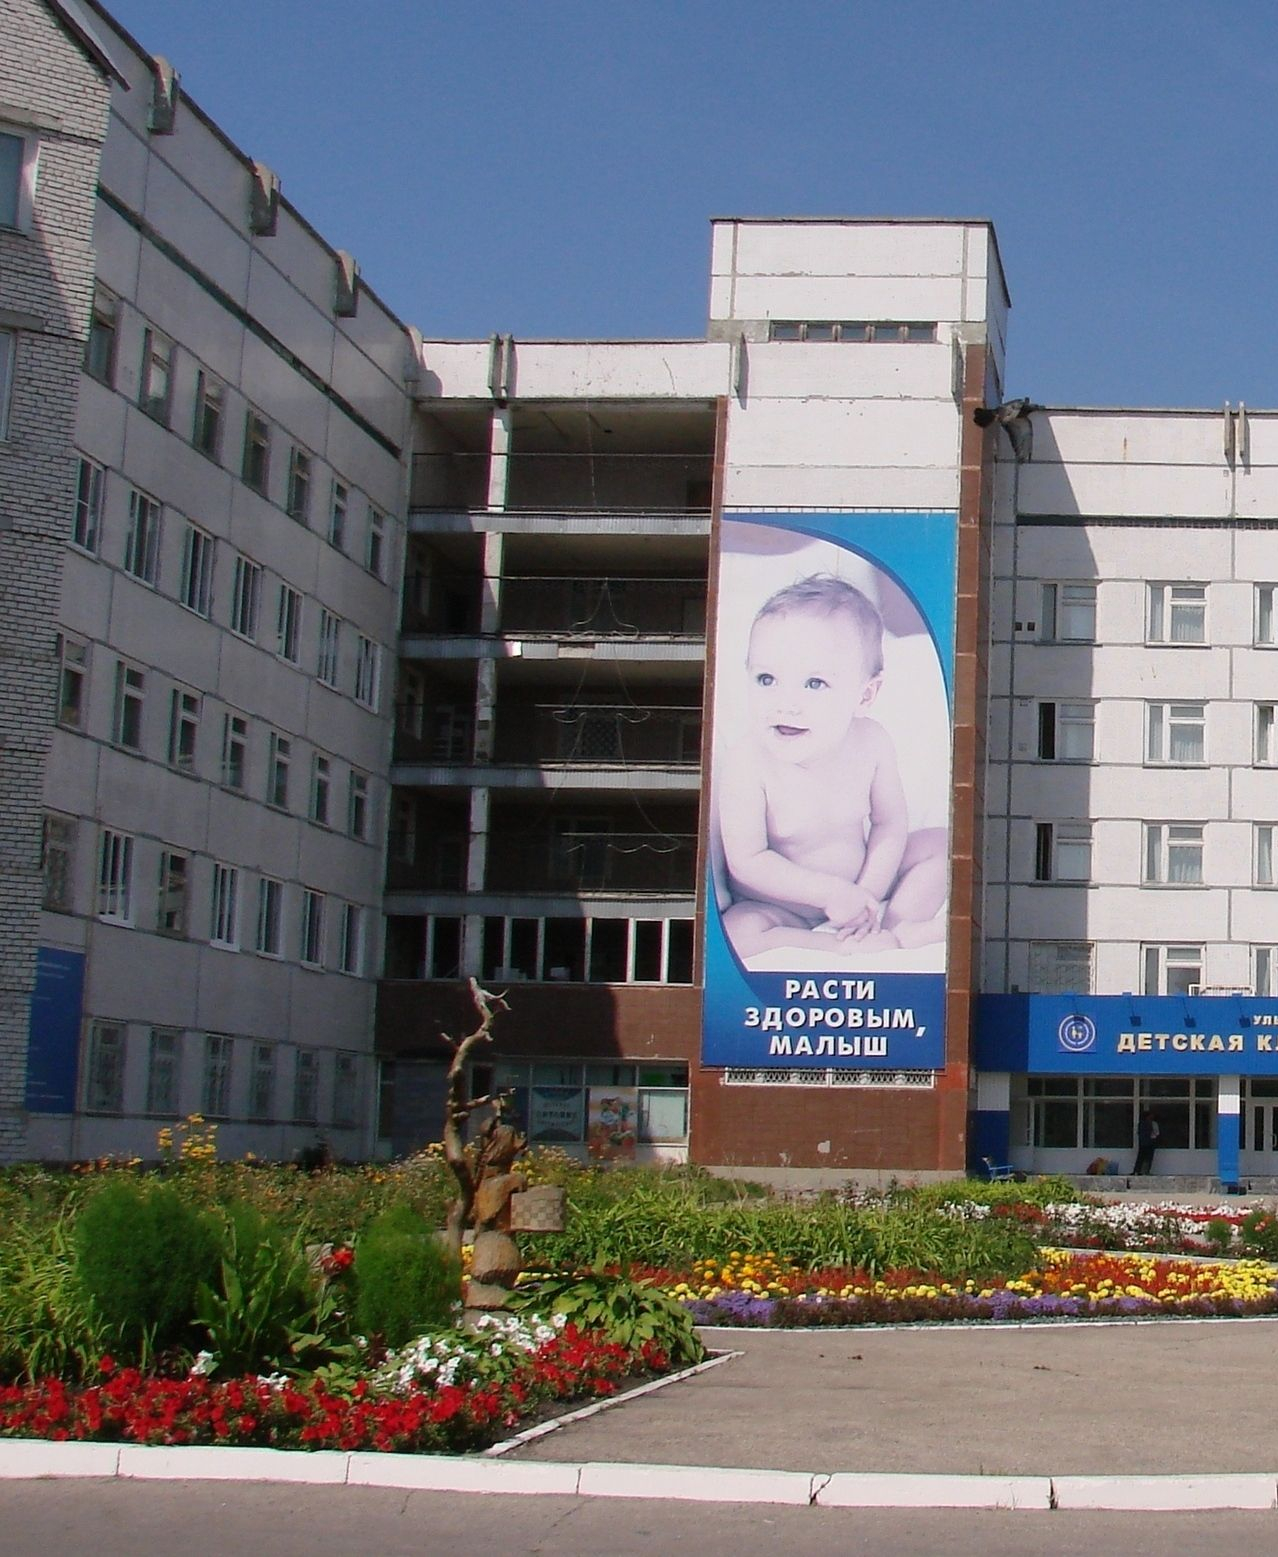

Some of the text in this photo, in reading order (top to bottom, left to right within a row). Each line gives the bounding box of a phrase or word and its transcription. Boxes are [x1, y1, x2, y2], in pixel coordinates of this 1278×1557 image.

[785, 979, 875, 1000] РАСТИ
[744, 1007, 926, 1037] ЗДОРОВЫМ,
[769, 1035, 888, 1056] МАЛЫШ
[1117, 1033, 1244, 1053] ДЕТСКАЯ
